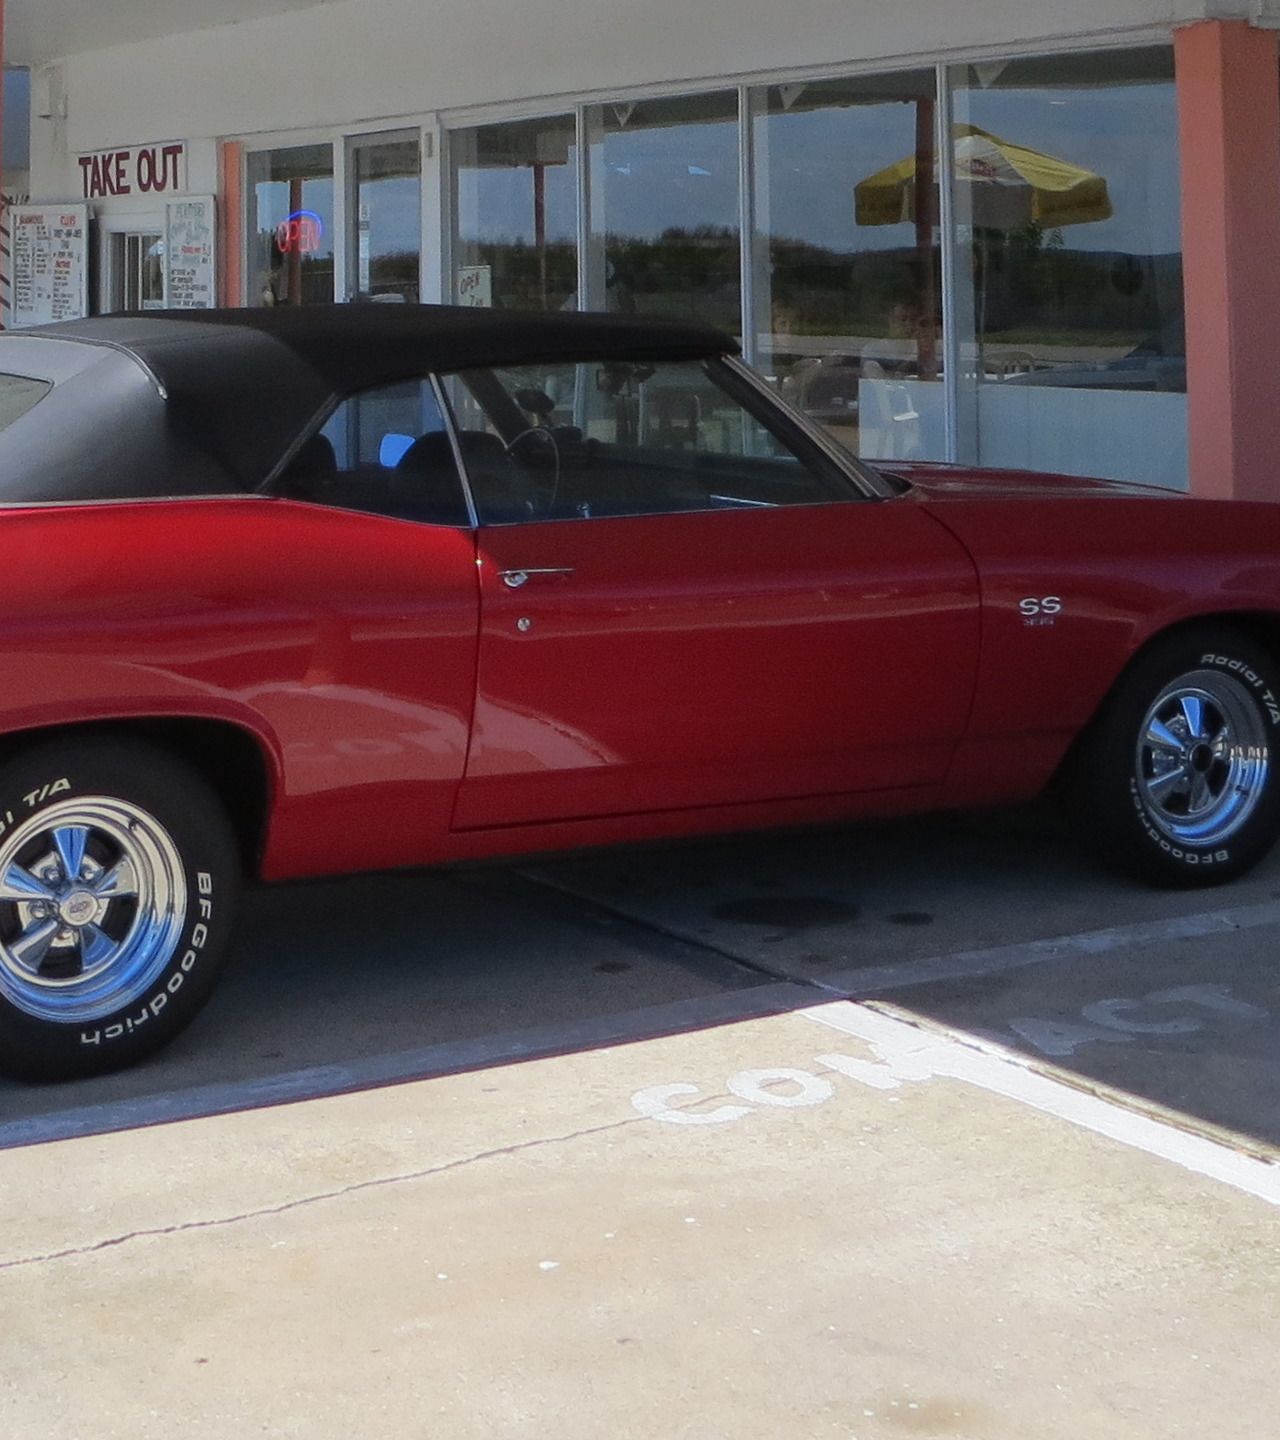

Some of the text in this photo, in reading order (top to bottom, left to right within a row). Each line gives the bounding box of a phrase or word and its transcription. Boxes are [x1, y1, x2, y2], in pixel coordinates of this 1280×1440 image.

[78, 144, 184, 199] TAKE OUT
[275, 218, 321, 254] OPEN
[1019, 595, 1062, 616] SS
[1200, 653, 1264, 688] Radial
[22, 776, 72, 807] T/A
[80, 871, 213, 1046] BFGoodrich
